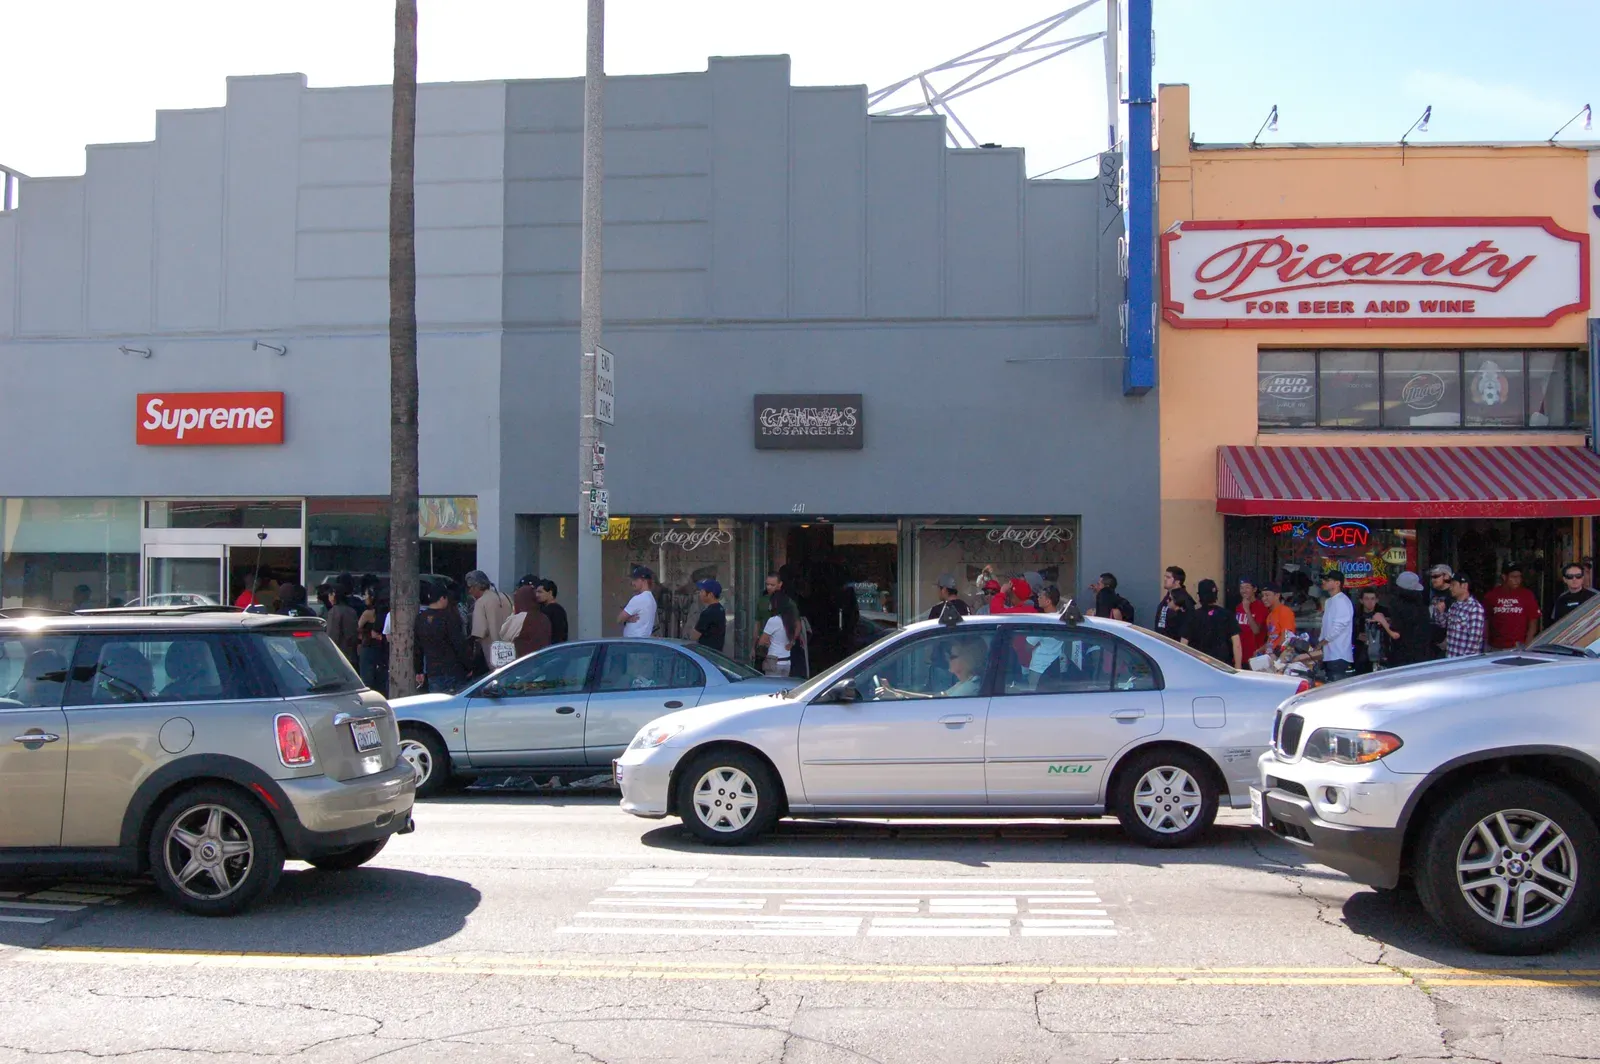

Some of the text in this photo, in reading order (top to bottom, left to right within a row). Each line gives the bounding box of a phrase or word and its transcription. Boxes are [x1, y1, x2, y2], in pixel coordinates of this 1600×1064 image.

[1194, 235, 1538, 301] Picanty
[1245, 299, 1476, 314] FOR BEER AND WINE
[601, 353, 610, 373] END
[597, 374, 614, 398] SCHOOL
[1274, 377, 1308, 385] BUD
[1266, 385, 1313, 394] LIGHT
[599, 398, 611, 419] ZONE
[143, 398, 274, 439] Supreme
[791, 503, 806, 514] 441
[1317, 524, 1368, 545] OPEN
[1386, 550, 1406, 560] ATM
[1337, 560, 1372, 573] Modelo
[1048, 764, 1093, 774] NGV
